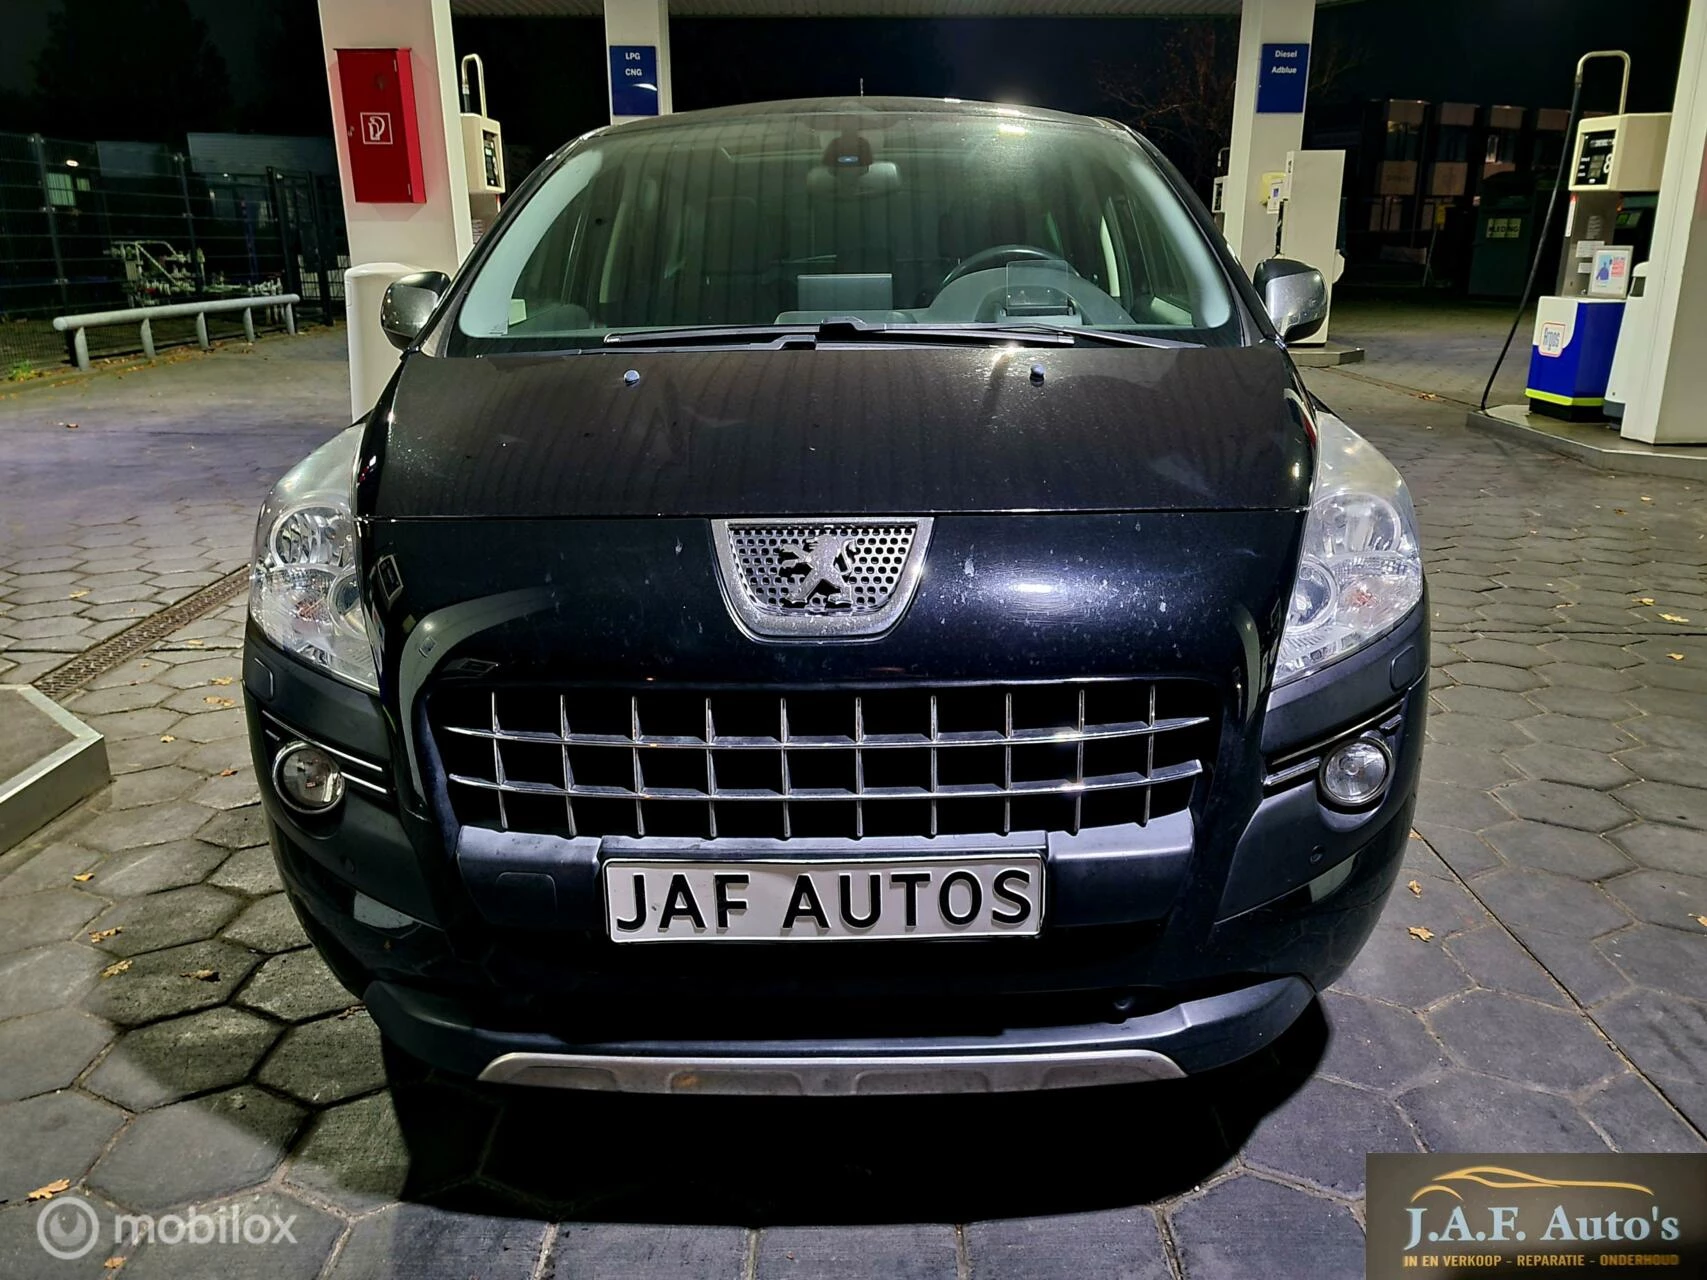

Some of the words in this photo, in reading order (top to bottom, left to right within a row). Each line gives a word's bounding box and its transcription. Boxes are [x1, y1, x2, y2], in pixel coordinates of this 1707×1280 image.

[625, 52, 641, 60] LPG
[1274, 50, 1298, 58] Diesel
[625, 68, 643, 76] CNG
[1271, 66, 1297, 74] Adblue
[616, 872, 751, 932] JAF
[781, 869, 1033, 930] AUTOS
